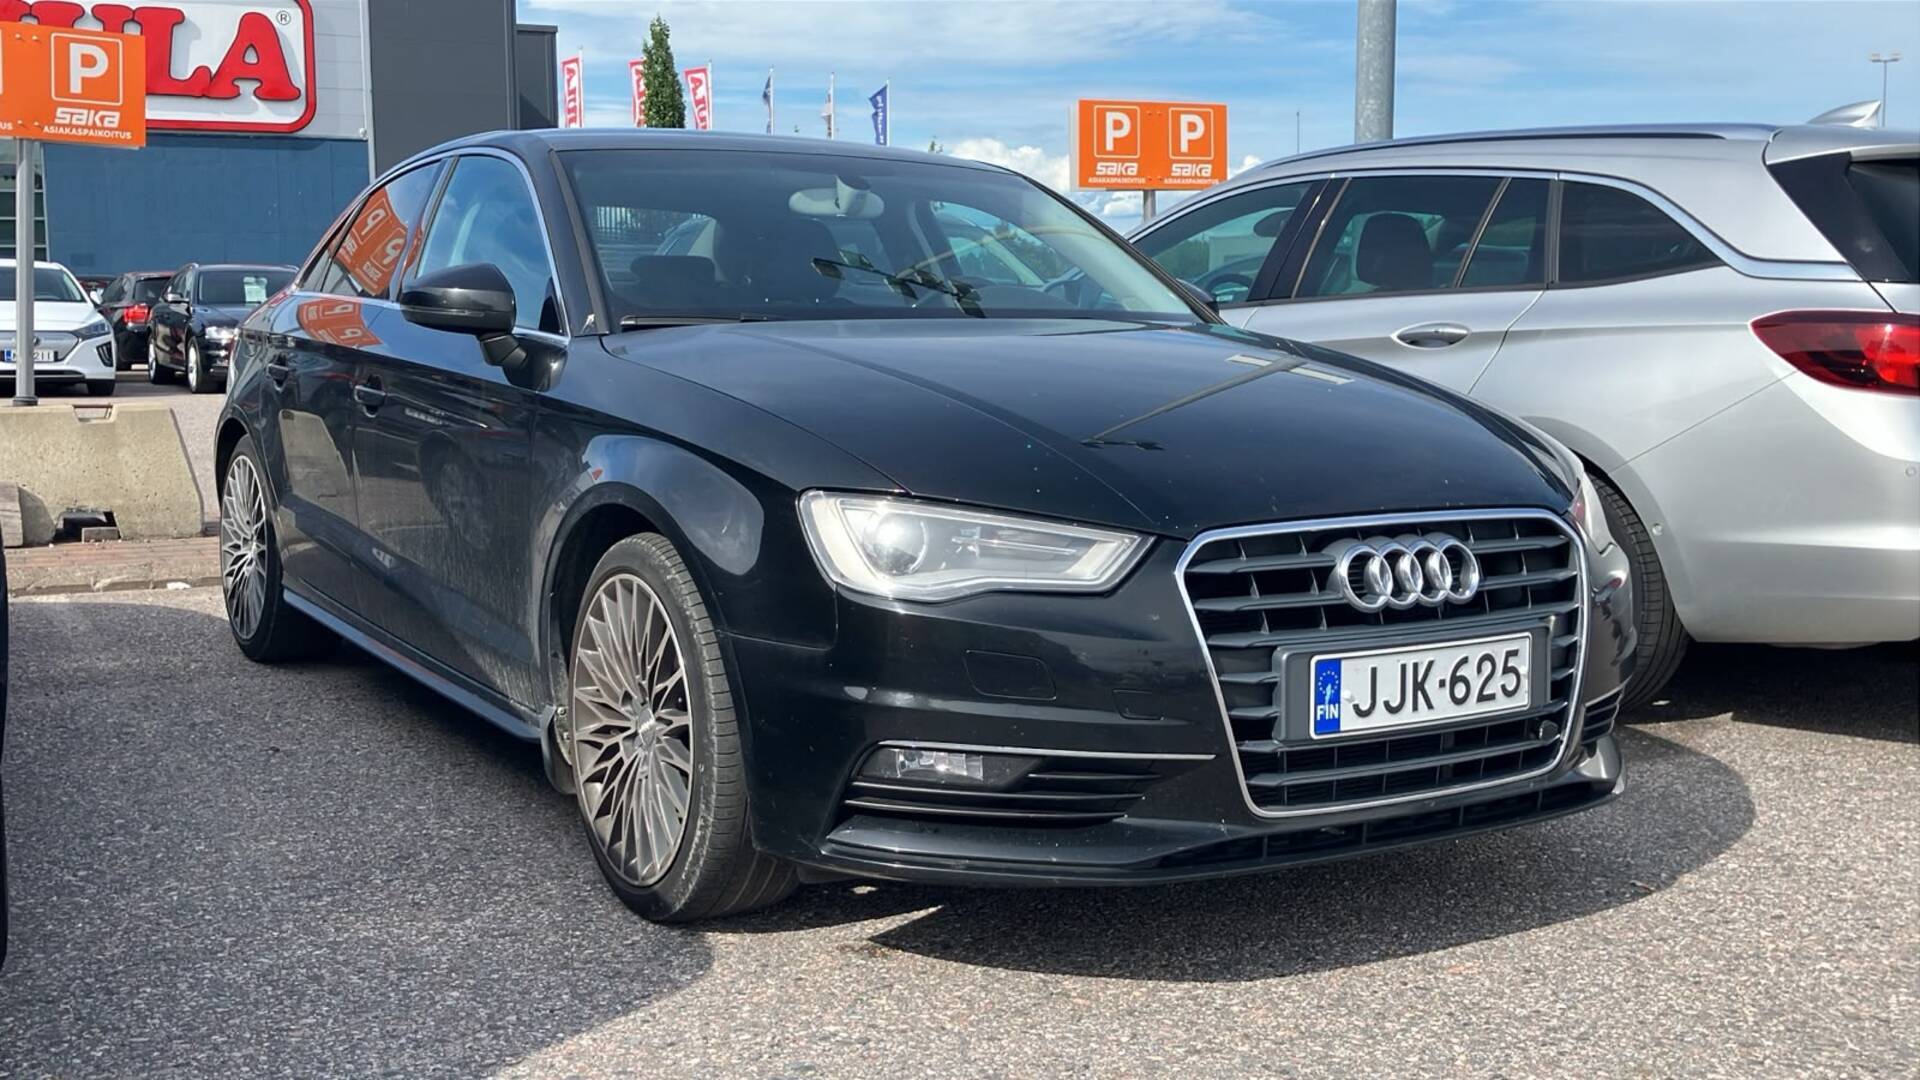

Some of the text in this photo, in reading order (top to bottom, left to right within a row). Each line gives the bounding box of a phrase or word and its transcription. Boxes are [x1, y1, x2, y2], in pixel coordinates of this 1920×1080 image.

[70, 43, 108, 94] P
[42, 125, 132, 139] ASIAKASPAIKOITUS
[1106, 111, 1131, 151] P
[1180, 114, 1205, 153] P
[1352, 649, 1521, 718] JJK-625
[1316, 703, 1339, 721] FIN
